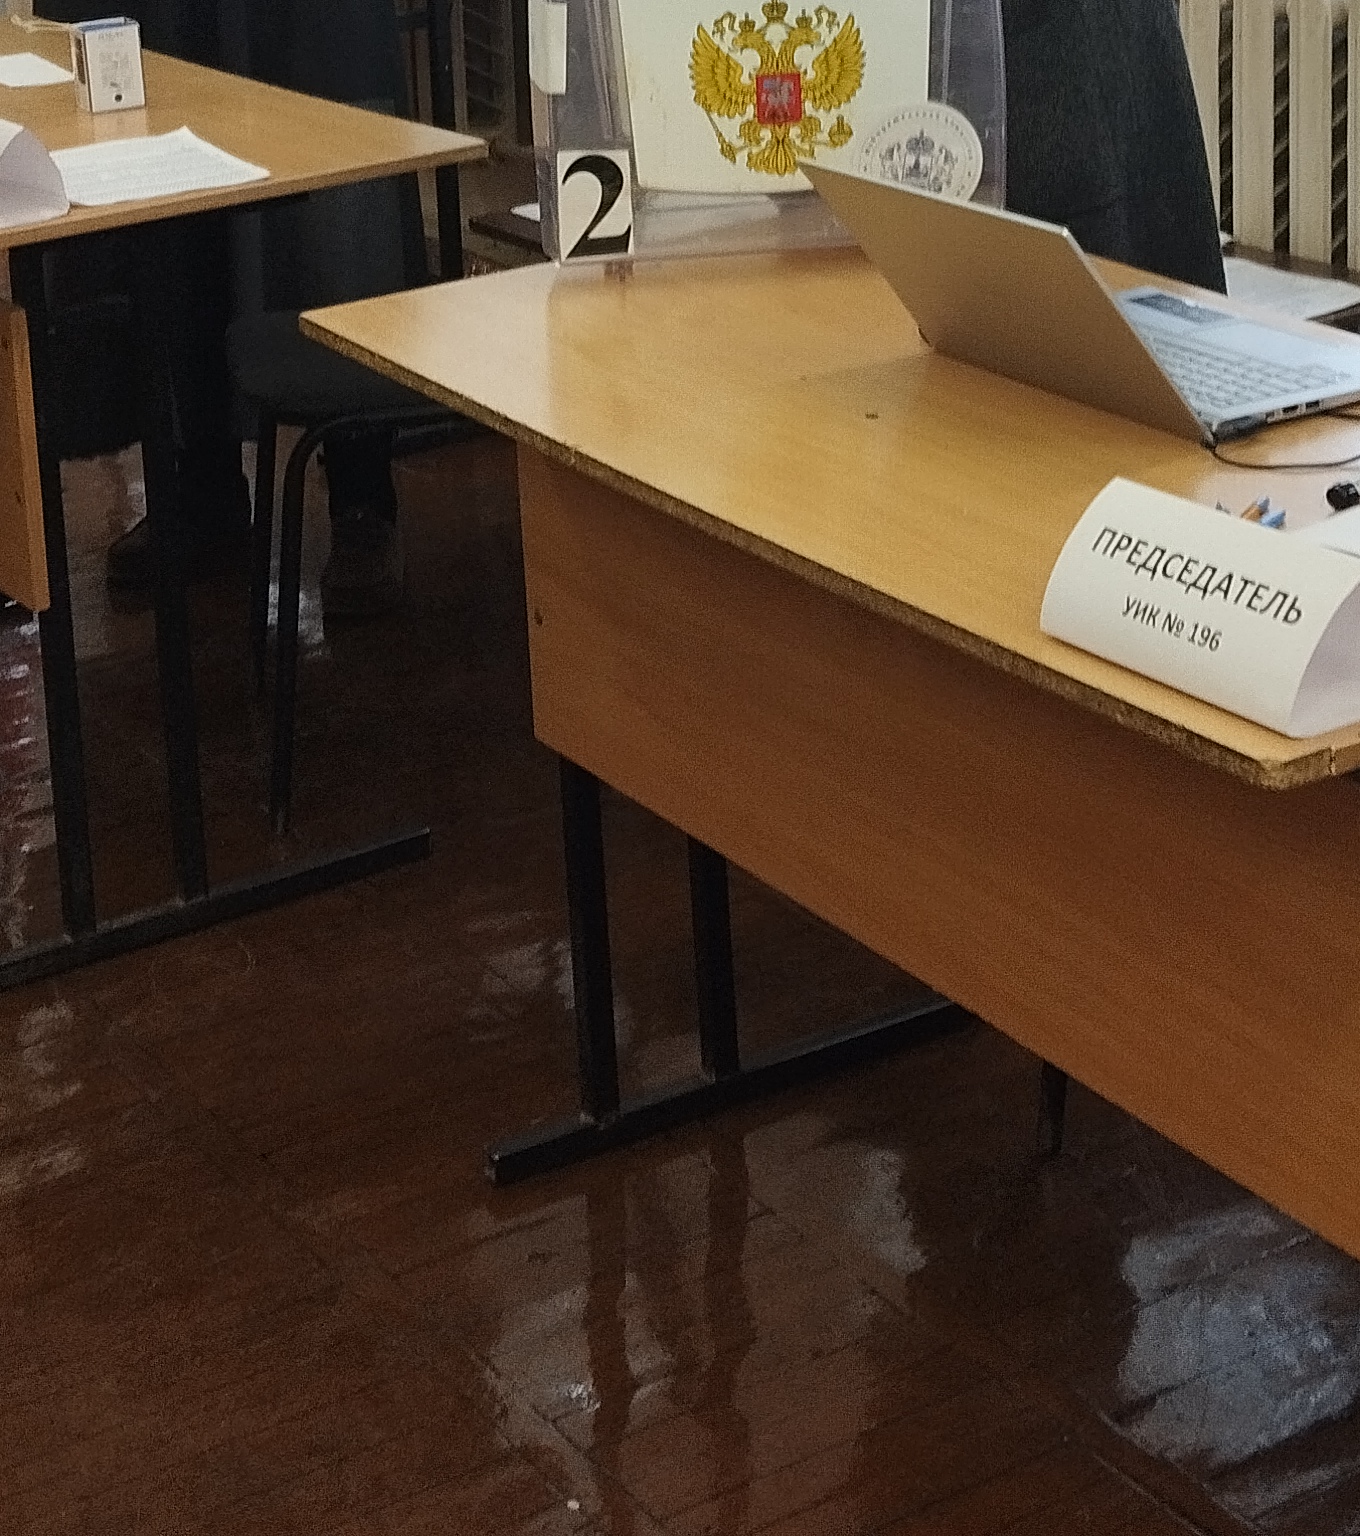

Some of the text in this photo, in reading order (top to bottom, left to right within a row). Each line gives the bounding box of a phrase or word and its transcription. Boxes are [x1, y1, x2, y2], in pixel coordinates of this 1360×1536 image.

[561, 154, 632, 260] 2
[1092, 526, 1303, 626] ПРЕДСЕДАТЕЛЬ
[1122, 595, 1223, 652] УИК № 196
